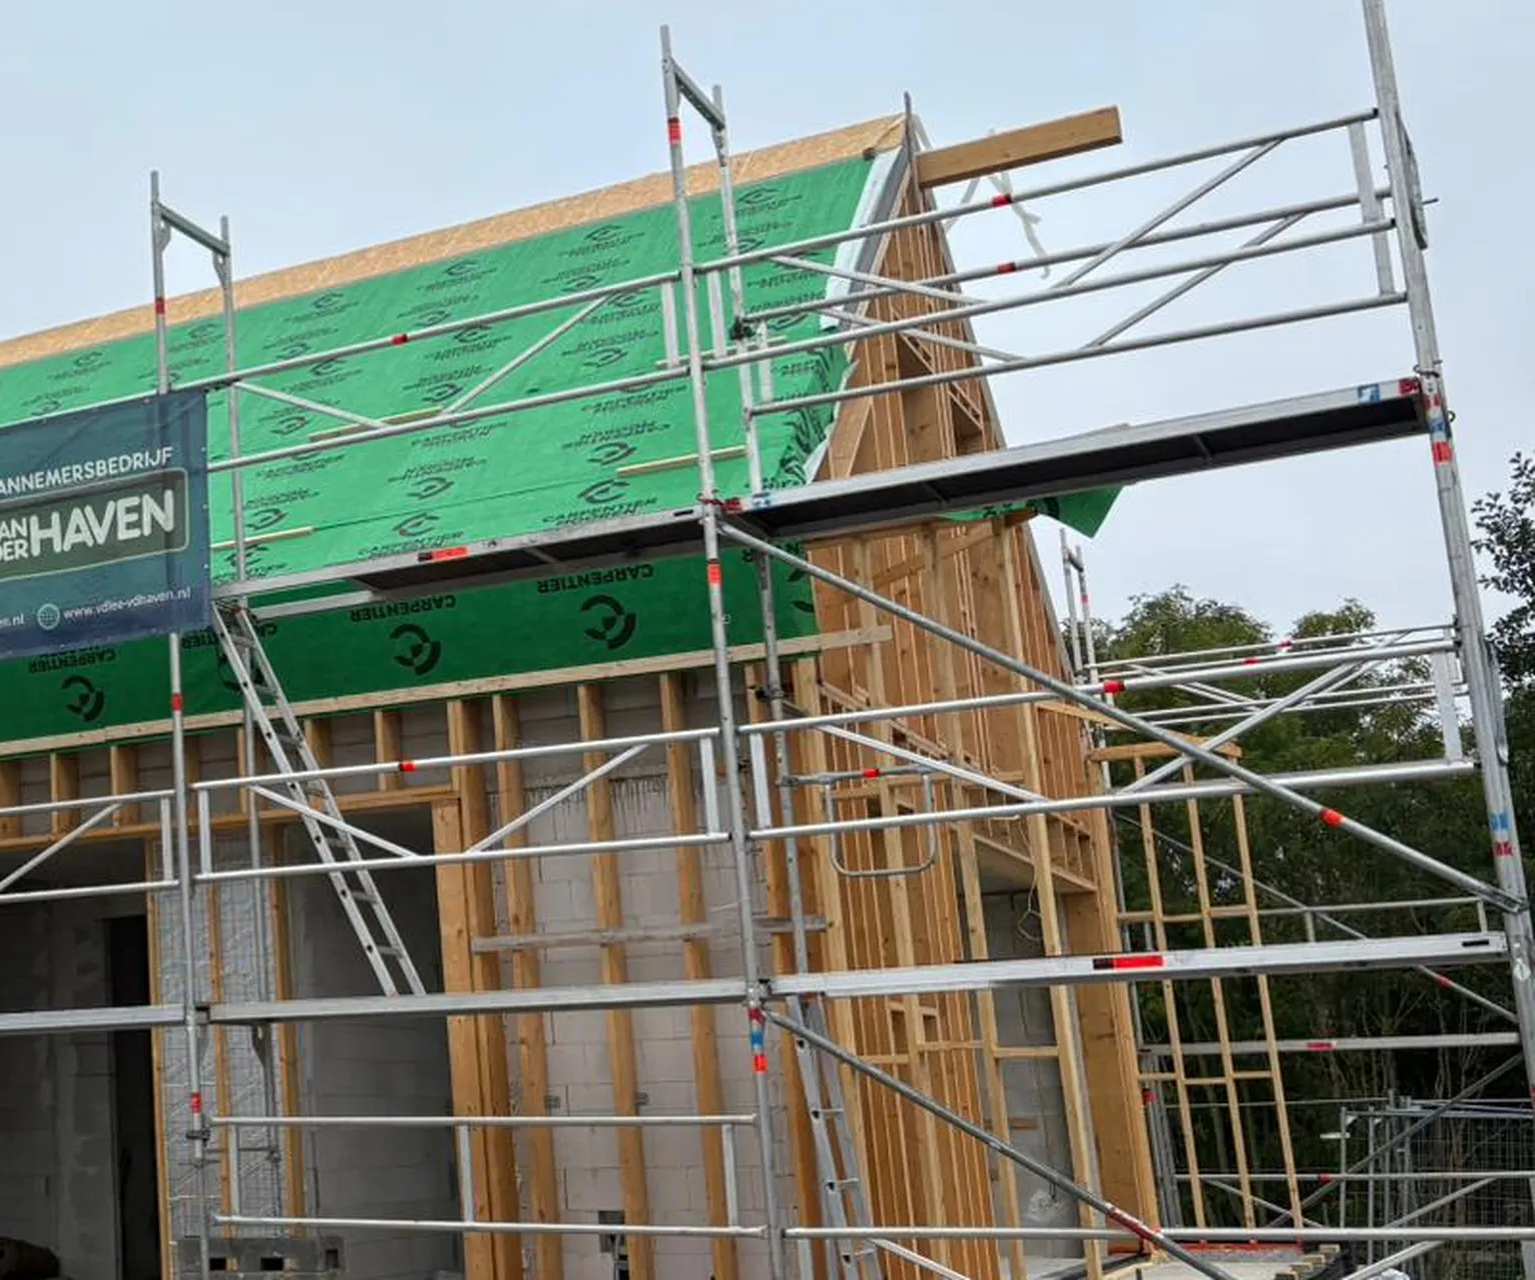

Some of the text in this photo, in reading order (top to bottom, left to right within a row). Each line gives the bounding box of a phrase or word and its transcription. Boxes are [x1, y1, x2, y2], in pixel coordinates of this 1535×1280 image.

[29, 489, 175, 557] HAVEN
[536, 563, 654, 594] CARPENTIER
[349, 594, 457, 622] CARPENTIER
